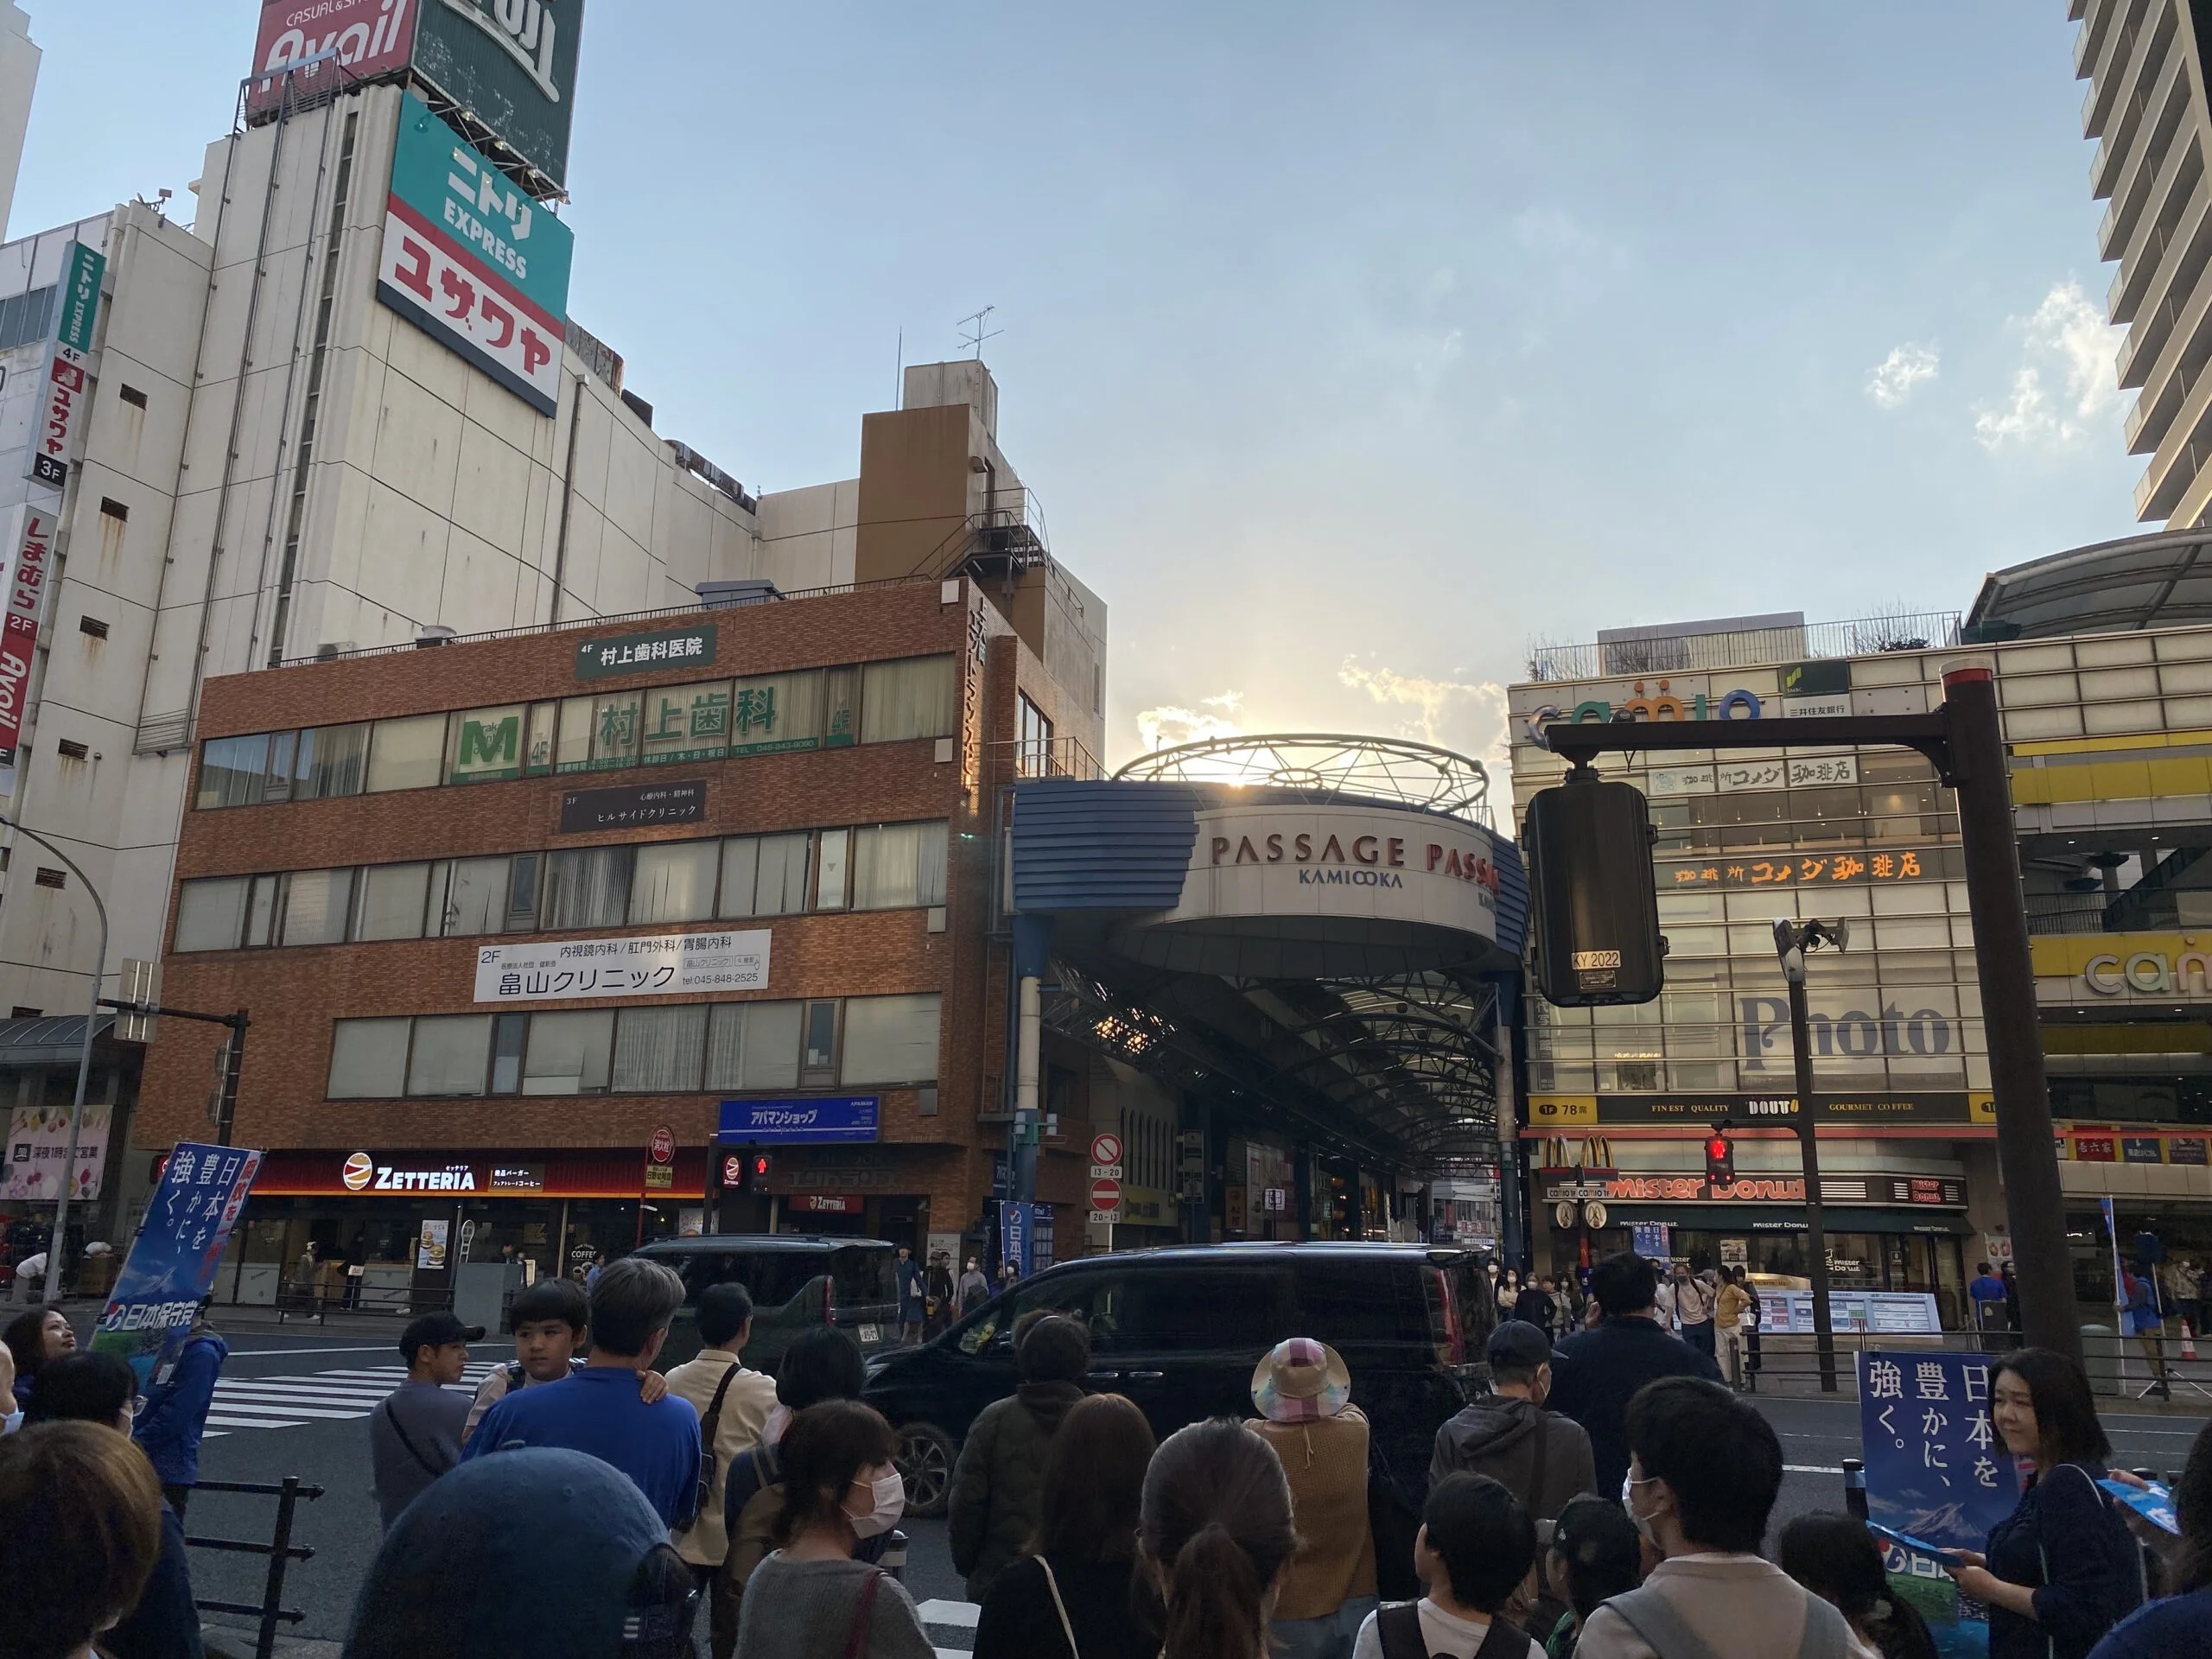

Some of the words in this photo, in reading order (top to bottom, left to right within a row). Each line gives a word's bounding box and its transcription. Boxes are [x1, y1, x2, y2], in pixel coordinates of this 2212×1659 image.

[258, 0, 407, 93] Avail
[448, 147, 534, 240] ニトリ
[444, 197, 527, 279] EXPRESS
[394, 235, 552, 377] ユザワヤ
[69, 302, 86, 344] EXPRESS
[62, 348, 80, 362] 4F
[47, 387, 71, 454] ユザワヤ
[40, 460, 60, 480] 3F
[13, 517, 48, 610] しまむら
[10, 615, 32, 632] 2F
[582, 645, 594, 653] 4F
[601, 636, 702, 665] 村上歯科医院
[600, 686, 775, 747] 村上歯科
[1790, 705, 1845, 717] 三井住友銀行
[460, 716, 518, 765] M
[567, 797, 578, 805] 3F
[597, 805, 696, 823] ヒルサイドクリニック
[1211, 834, 1405, 866] PASSAGE
[1299, 869, 1403, 889] KAMIOOKA
[481, 950, 501, 963] 2F
[1573, 953, 1587, 968] KY
[1591, 952, 1619, 967] 2022
[499, 966, 675, 995] 畠山クリニック
[751, 1109, 818, 1125] アパマンショップ
[1542, 1106, 1556, 1115] 1F
[1690, 1104, 1729, 1113] QUALITY
[1878, 1103, 1915, 1111] COFFEE
[32, 1146, 99, 1160] 深夜1時営業
[1094, 1168, 1120, 1177] 13-20
[192, 1155, 241, 1250] 日本を
[1093, 1212, 1117, 1222] 20-13
[123, 1300, 200, 1331] 日本保守党
[1869, 1360, 1905, 1450] 強く。
[1914, 1361, 1951, 1487] 豊かに、
[1962, 1364, 1998, 1488] 日本を
